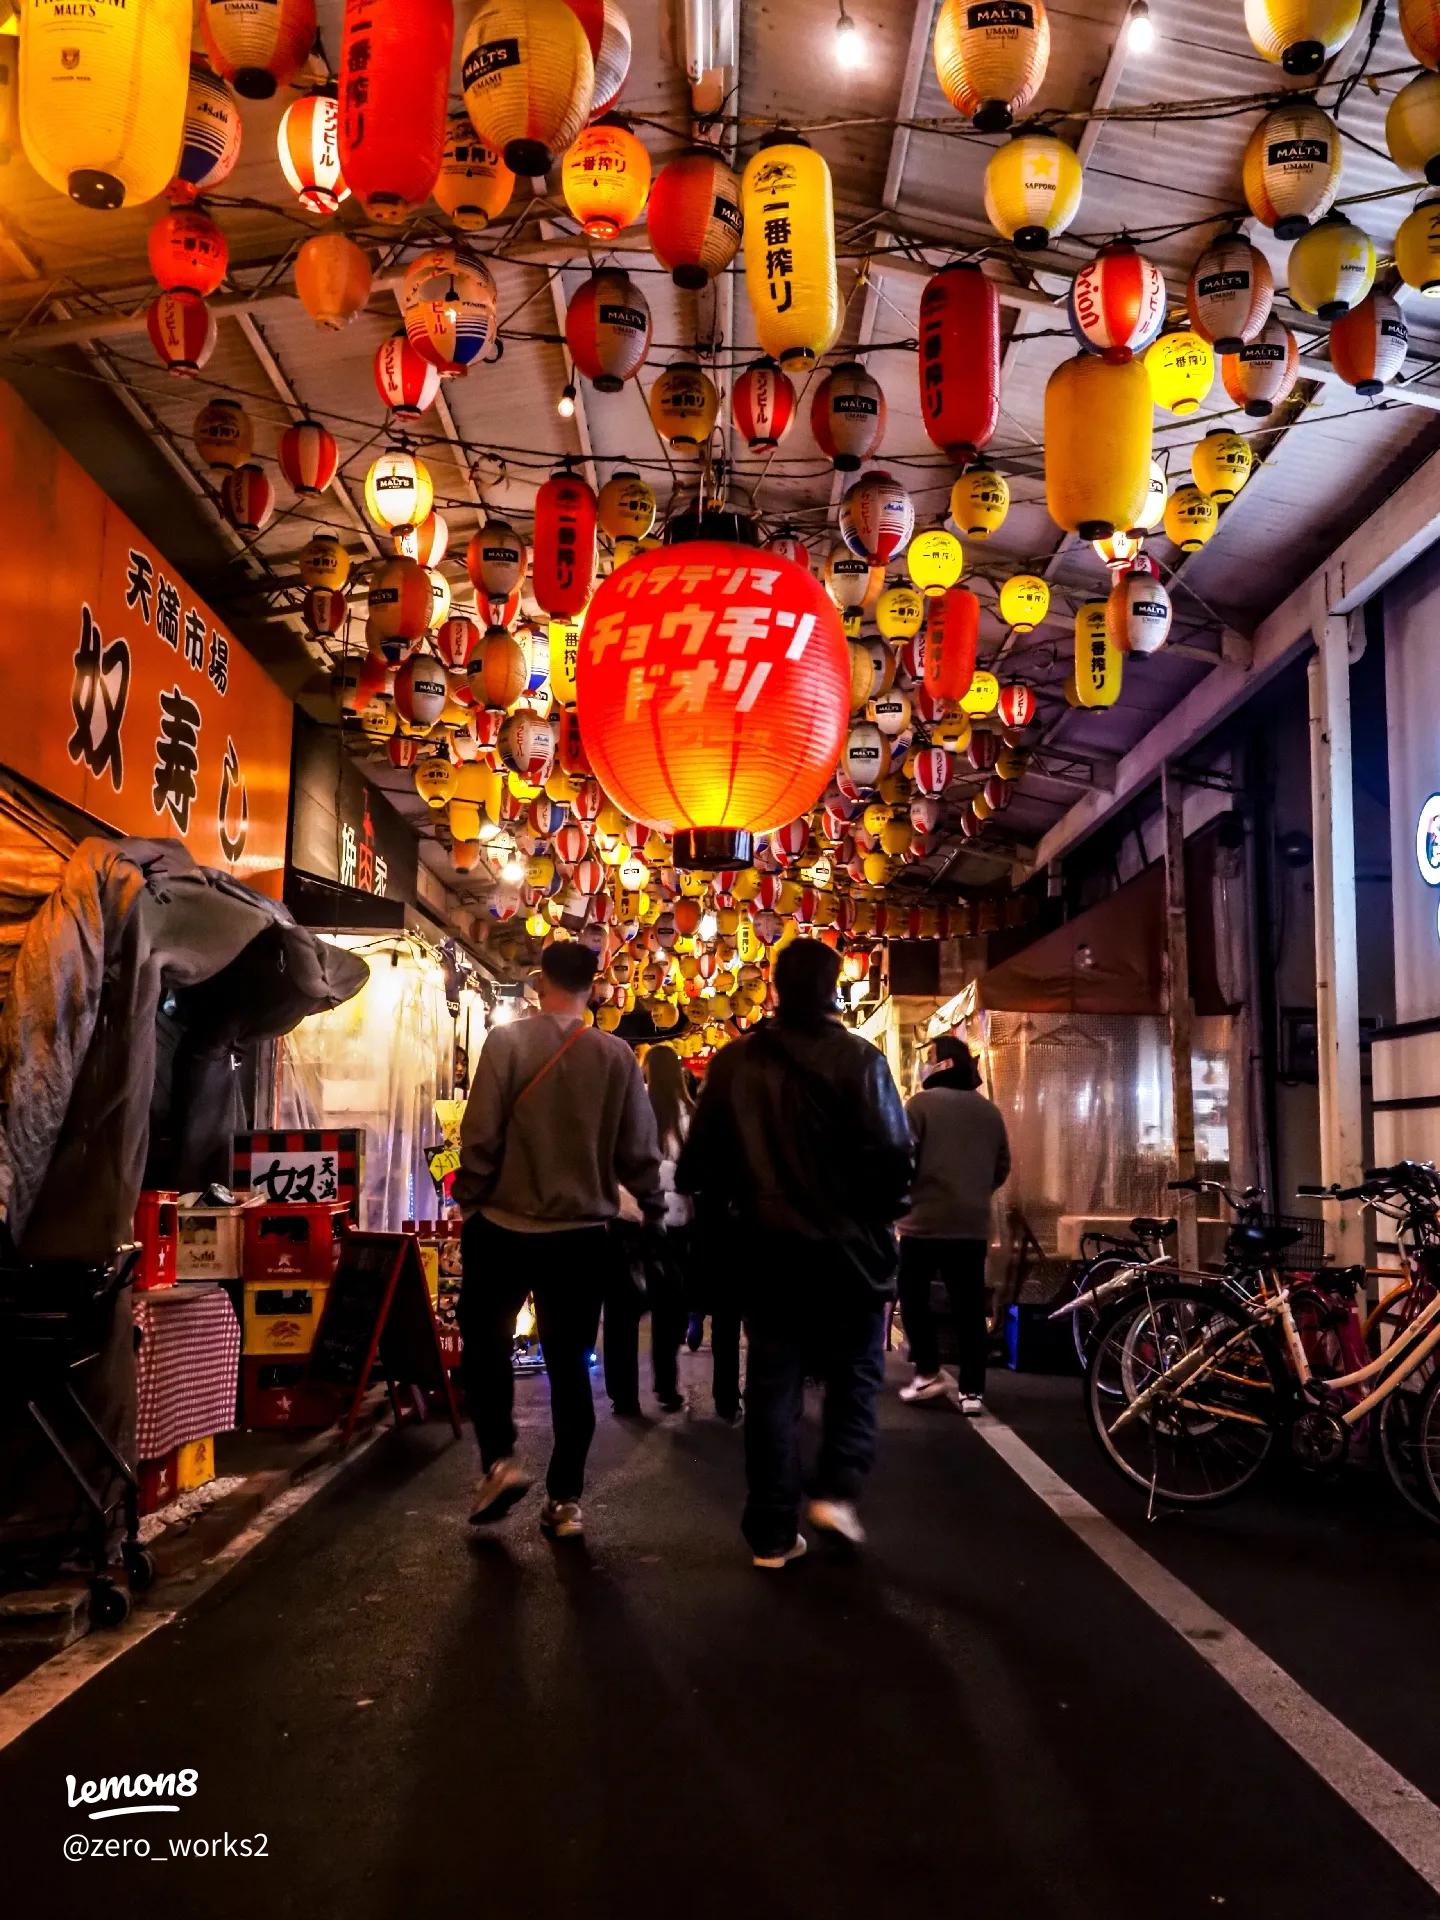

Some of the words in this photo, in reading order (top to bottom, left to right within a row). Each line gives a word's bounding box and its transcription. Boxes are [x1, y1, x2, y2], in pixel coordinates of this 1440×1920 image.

[977, 8, 1026, 21] MALT'S
[465, 48, 508, 79] MALT'S
[197, 102, 229, 124] Asahi
[1276, 145, 1321, 158] MALT'S
[571, 156, 627, 174] 一番搾り
[1024, 182, 1057, 191] SAPPORO
[762, 201, 796, 314] 一番搾り
[1204, 276, 1243, 290] MALT'S
[1077, 263, 1100, 330] Orion
[607, 311, 642, 324] MALT'S
[1244, 348, 1280, 358] MALT'S
[840, 400, 873, 410] MALT'S
[379, 478, 410, 489] MALT'S
[616, 564, 783, 599] ウラテンマ
[1138, 604, 1165, 616] MALT'S
[124, 547, 229, 697] 天満市場
[588, 604, 818, 666] チョウチン
[1091, 632, 1106, 690] 一番搾り
[623, 659, 774, 723] ドオリ
[253, 1159, 318, 1203] 奴
[319, 1156, 338, 1200] 天満
